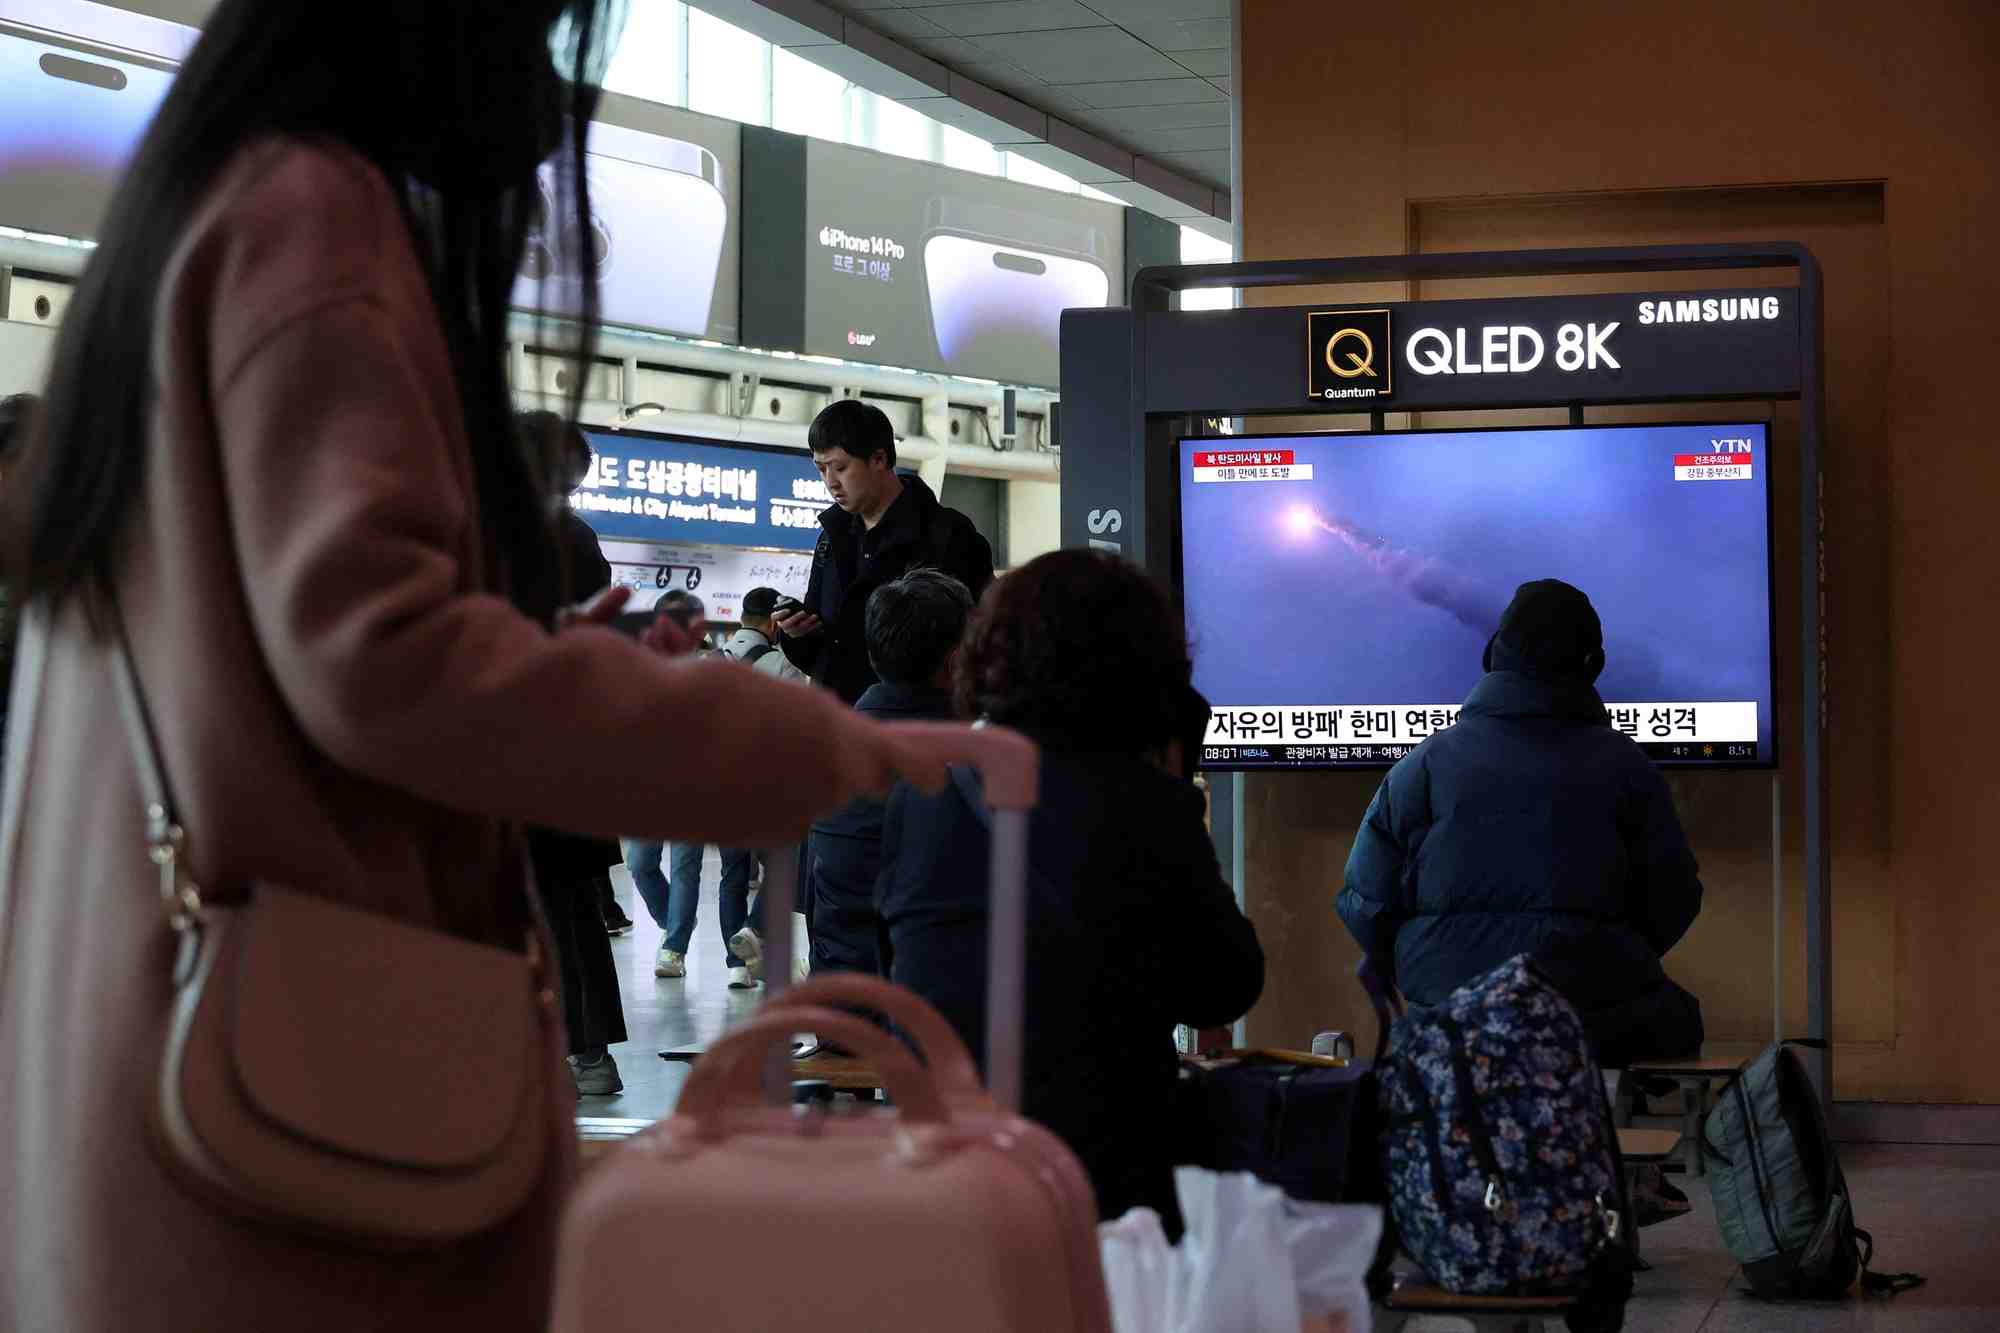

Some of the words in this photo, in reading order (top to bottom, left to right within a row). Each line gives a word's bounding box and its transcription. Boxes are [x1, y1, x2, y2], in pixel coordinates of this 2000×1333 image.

[830, 228, 870, 253] iPhone
[870, 236, 885, 256] 14
[885, 239, 904, 259] Pro
[832, 254, 854, 275] 프로
[857, 258, 868, 276] 그
[1638, 296, 1780, 324] SAMSUNG
[1406, 326, 1544, 375] QLED
[1555, 322, 1622, 371] 8K
[1324, 387, 1376, 399] Quantum
[1711, 439, 1752, 453] YTN
[1218, 452, 1262, 465] 탄도미사일
[1263, 452, 1281, 464] 발사
[1238, 468, 1257, 479] 만에
[1259, 468, 1269, 478] 또
[1271, 467, 1290, 478] 도발
[1688, 467, 1704, 479] 강원
[626, 459, 757, 502] 도심공항터미널
[1292, 709, 1343, 739] 방패'
[1350, 710, 1396, 738] 한미
[1648, 707, 1696, 737] 성격
[1205, 747, 1237, 760] 08:07
[1285, 746, 1327, 760] 관광비자
[1329, 746, 1349, 760] 발급
